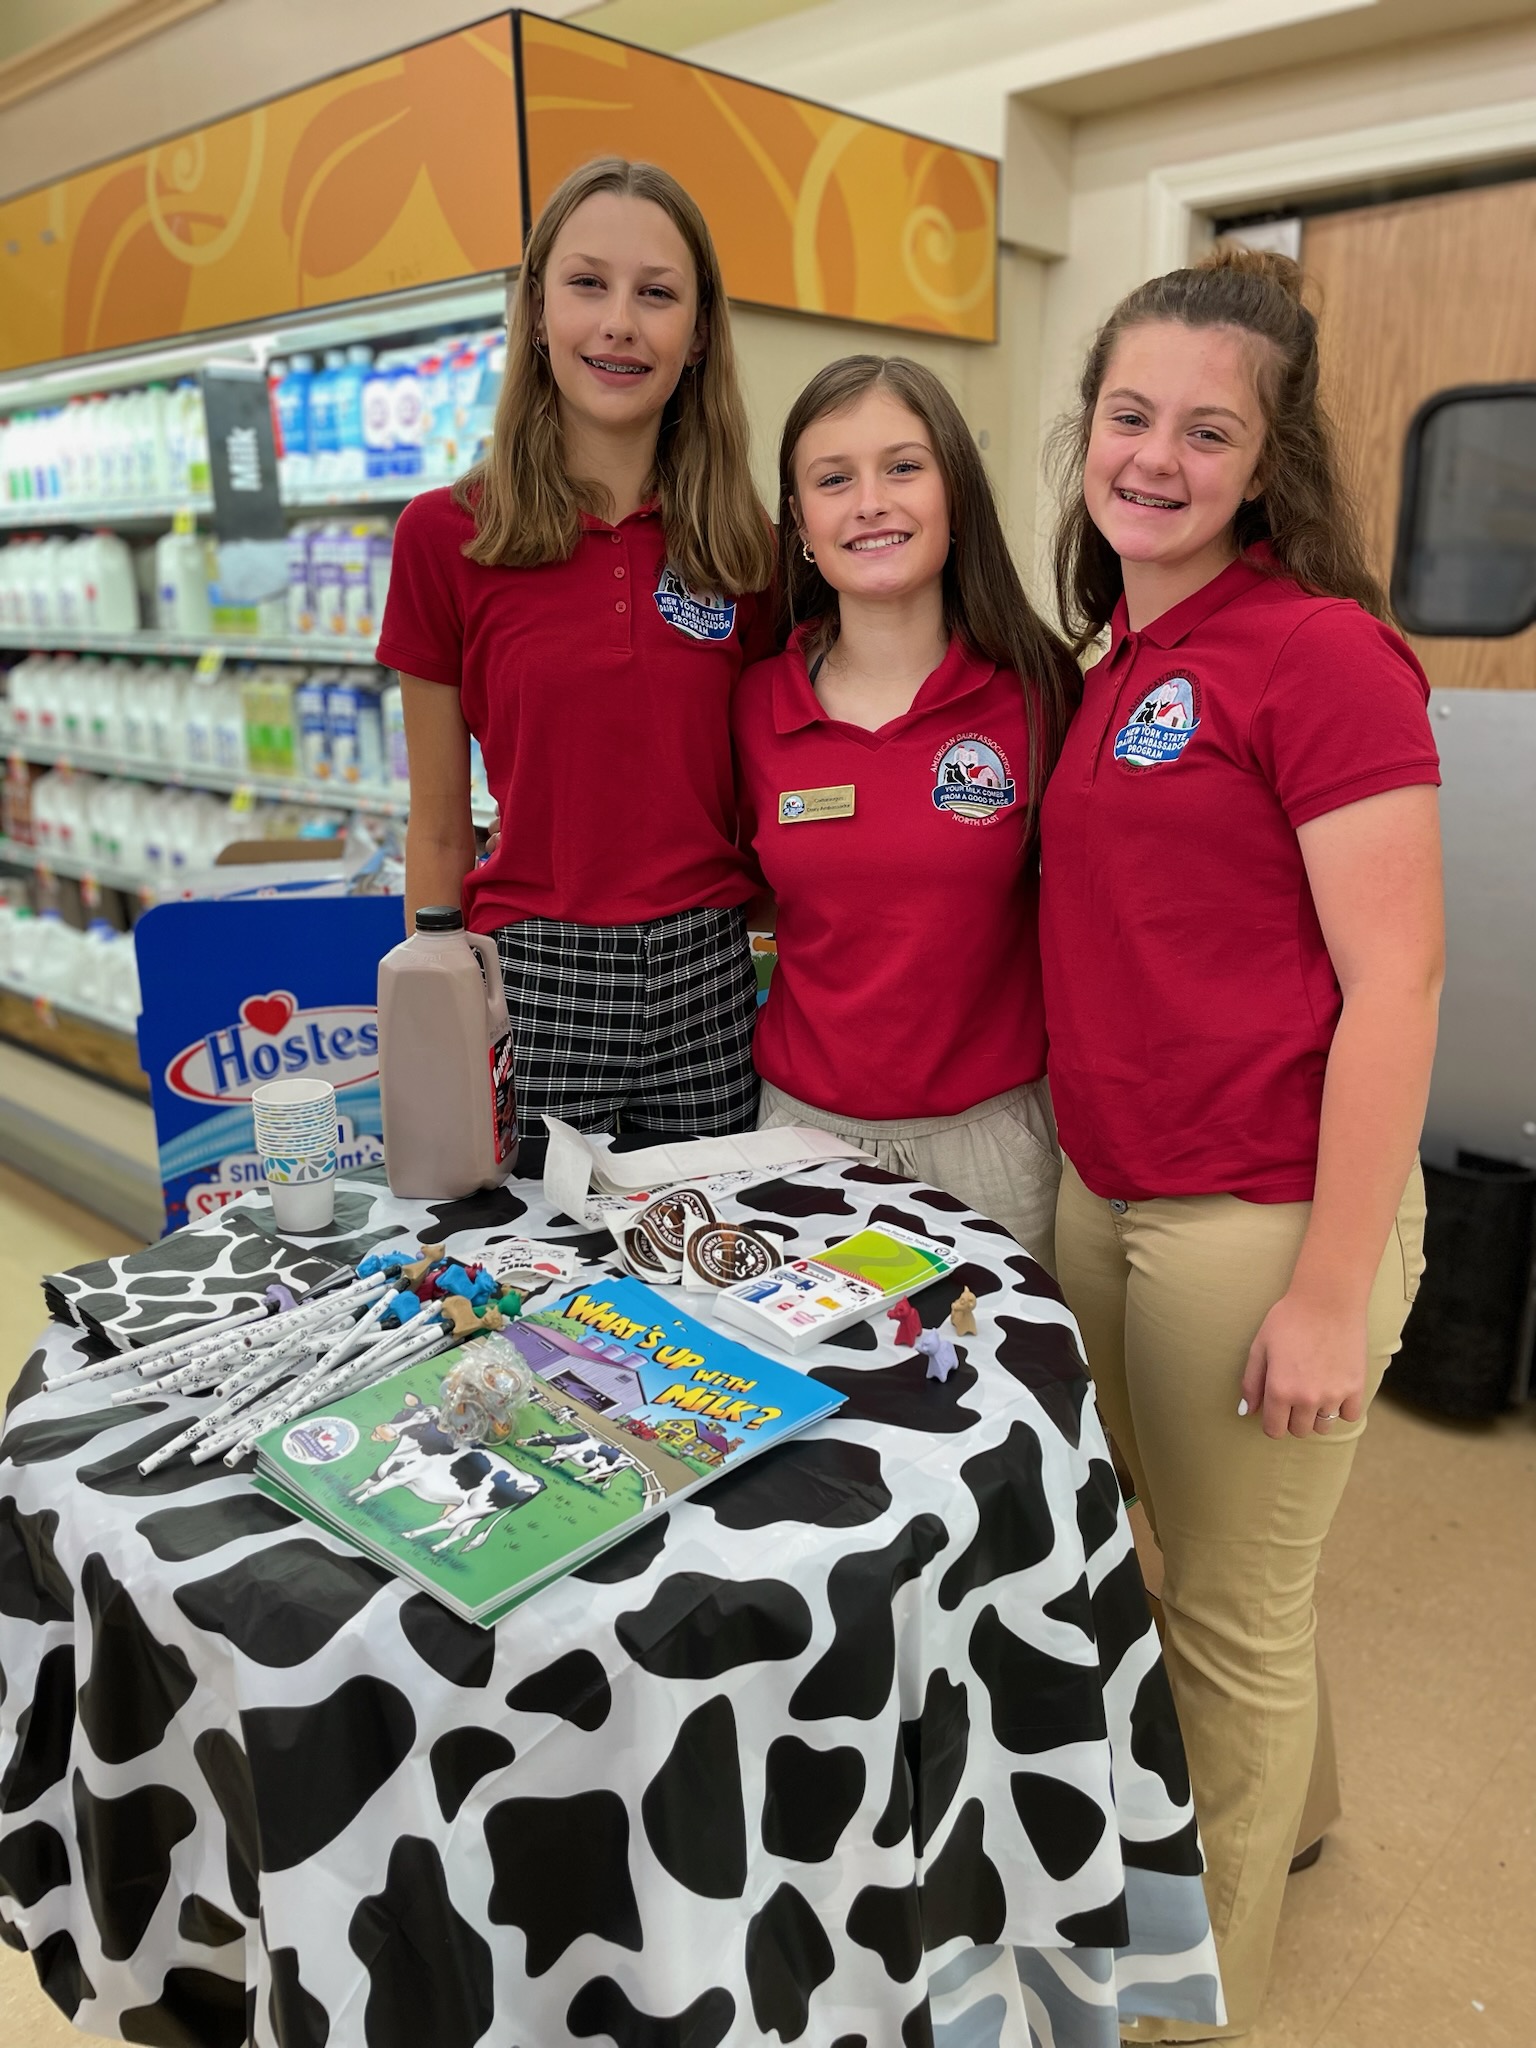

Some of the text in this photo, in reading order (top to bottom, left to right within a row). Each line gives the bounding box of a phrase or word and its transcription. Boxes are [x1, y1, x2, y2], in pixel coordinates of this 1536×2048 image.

[226, 427, 262, 491] Milk
[659, 604, 731, 630] DAIRY AMBASSADOR
[661, 596, 724, 622] NEW YORK STATE
[672, 614, 710, 636] PROGRAM
[1117, 736, 1139, 748] DAIRY
[1125, 726, 1188, 742] NEW YORK STATE
[930, 733, 1012, 775] AMERICAN DAIRY ASSOCIATION
[1127, 744, 1163, 758] PROGRAM
[940, 794, 960, 802] FROM
[968, 794, 988, 804] GOOD
[988, 798, 1009, 806] PLACE
[945, 785, 1004, 798] YOUR MILK COMES
[952, 813, 1000, 826] NORTH EAST
[204, 1022, 379, 1096] Hostes
[660, 1226, 683, 1246] FRESH
[703, 1236, 723, 1274] FARM FRESH
[749, 1244, 765, 1276] REAL MILK
[496, 1263, 532, 1276] MILK
[562, 1295, 667, 1349] WHAT'S
[652, 1345, 706, 1370] UP
